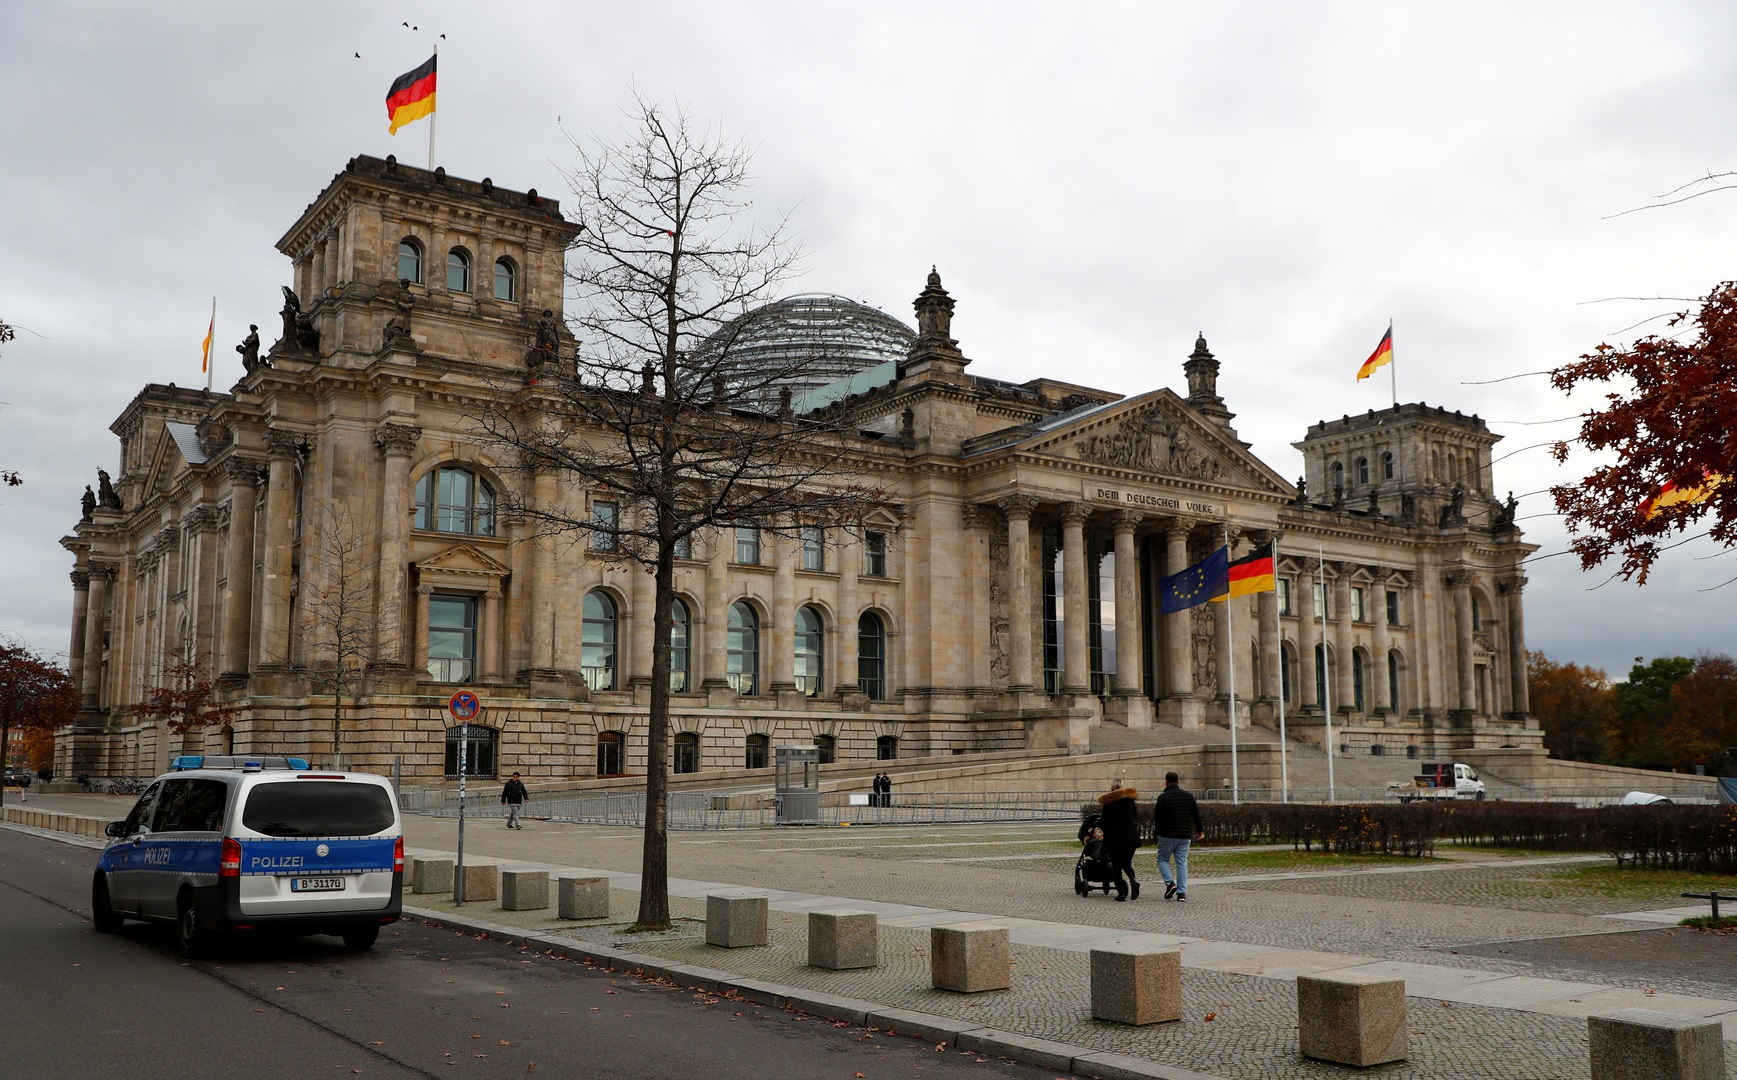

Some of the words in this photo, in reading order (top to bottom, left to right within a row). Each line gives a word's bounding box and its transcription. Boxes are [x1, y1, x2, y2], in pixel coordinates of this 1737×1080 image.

[1097, 488, 1119, 500] DEM
[1126, 493, 1180, 509] DEUTSCHEN
[1186, 502, 1213, 514] VOLKE
[144, 847, 171, 865] POLIZEI
[251, 856, 304, 868] POLIZEI
[301, 879, 308, 889] B
[313, 878, 341, 889] 31170
